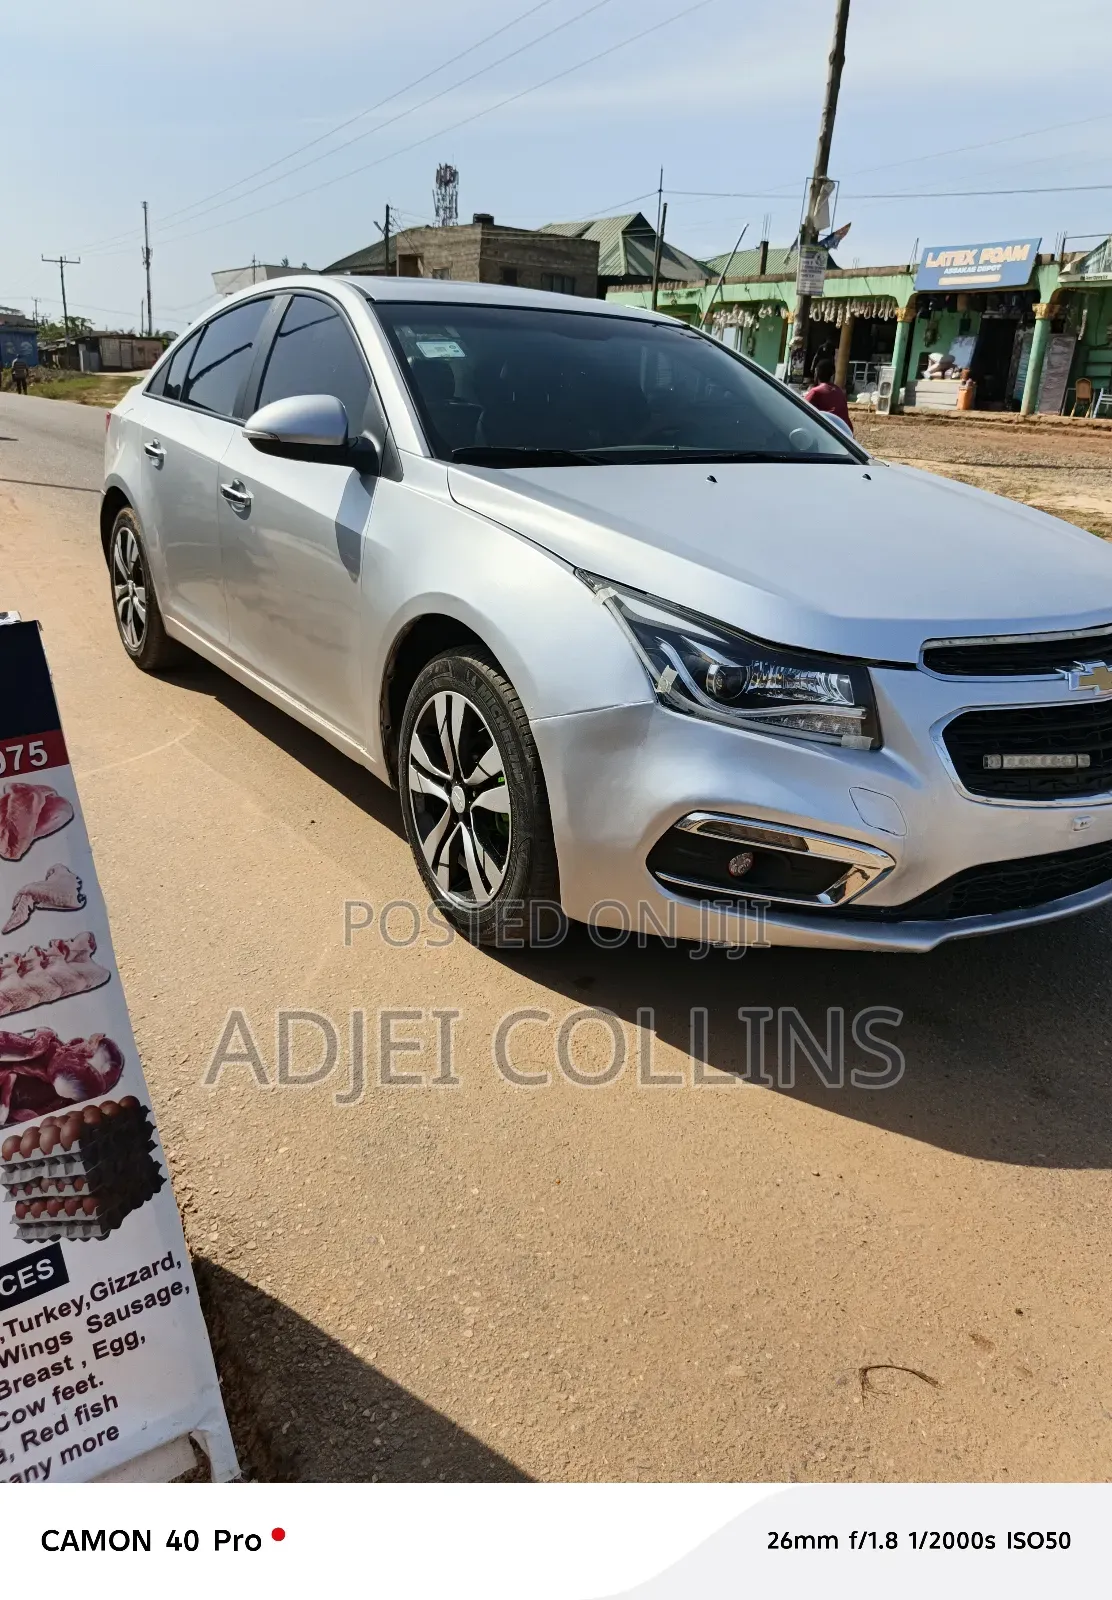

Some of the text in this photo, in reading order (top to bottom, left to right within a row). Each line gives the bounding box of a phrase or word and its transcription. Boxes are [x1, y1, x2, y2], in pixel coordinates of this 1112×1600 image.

[926, 244, 1031, 268] LATEX FOAM
[977, 264, 1002, 273] DEPOT
[0, 1258, 54, 1296] CES
[0, 1281, 190, 1369] Wings Sausage,
[93, 1329, 145, 1360] Egg,
[52, 1373, 104, 1405] feet.
[21, 1413, 69, 1452] Red
[75, 1394, 119, 1425] fish
[60, 1425, 119, 1465] more
